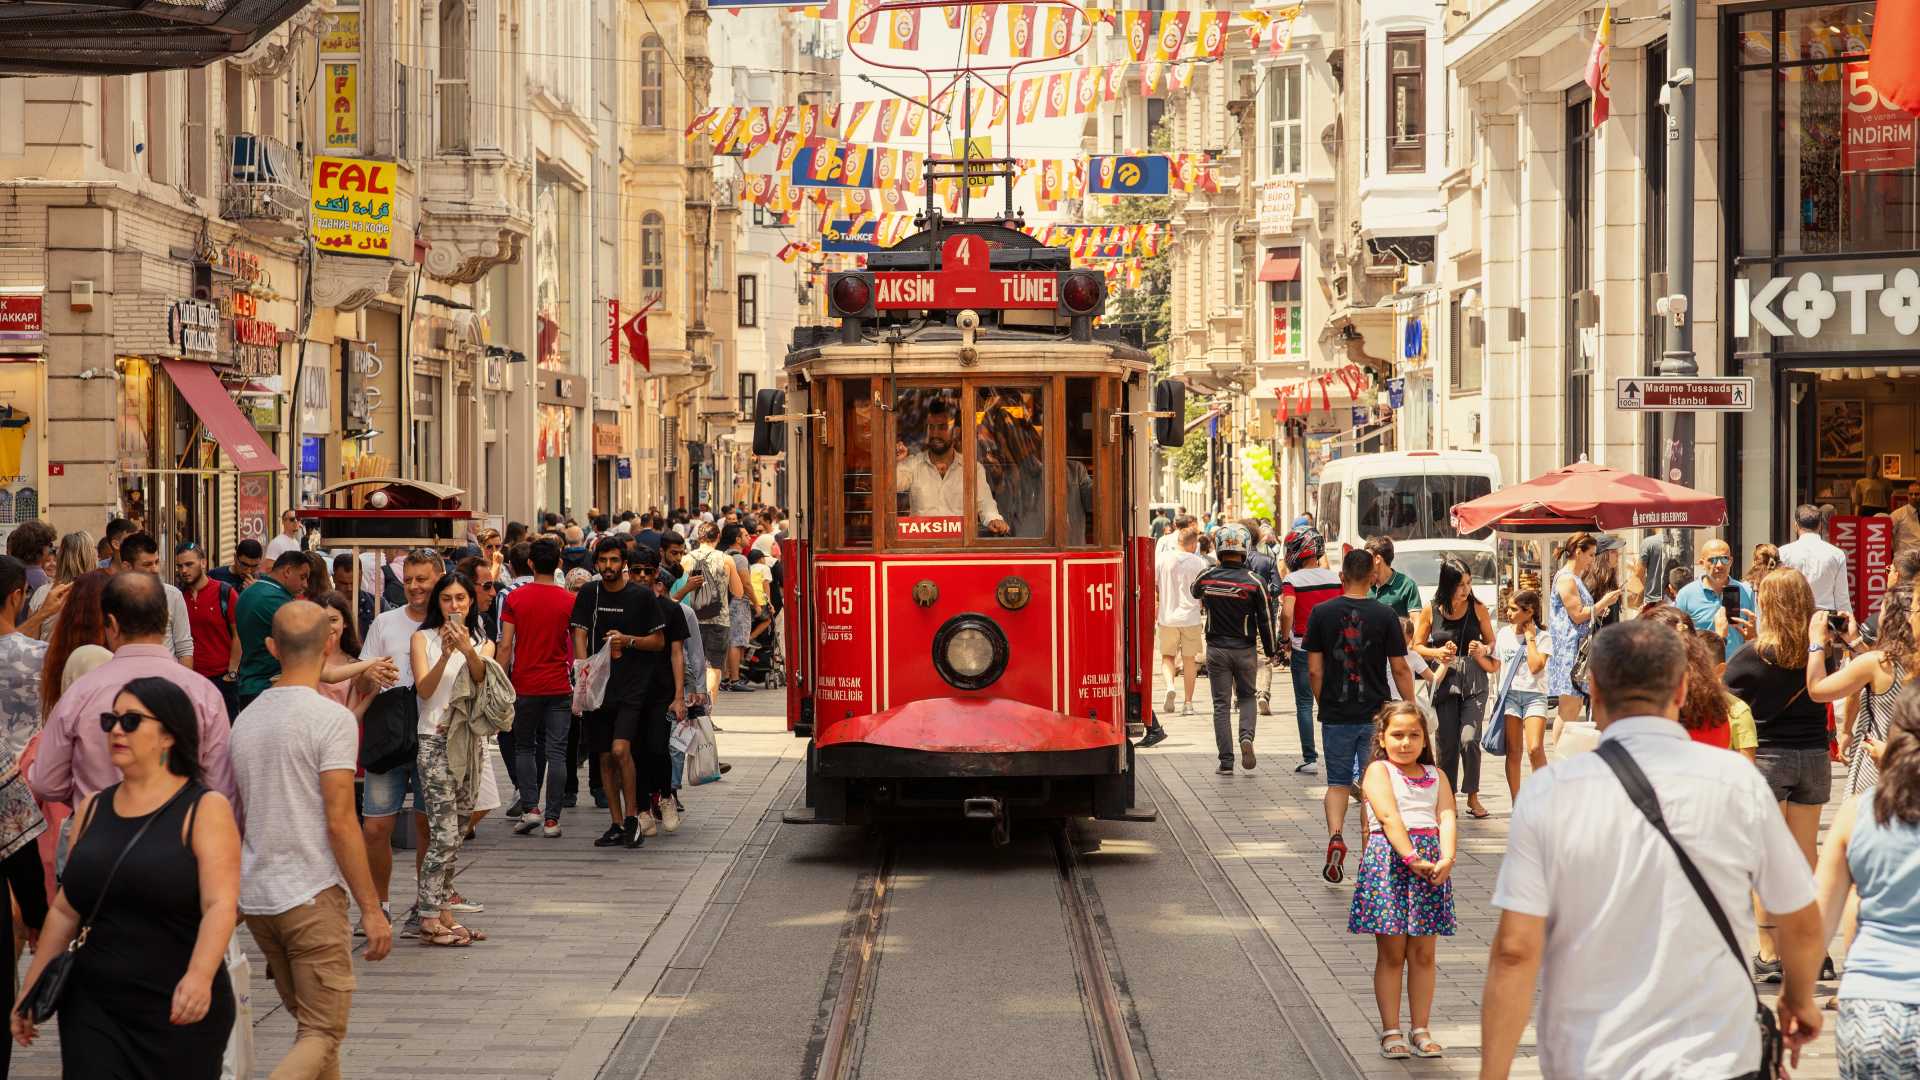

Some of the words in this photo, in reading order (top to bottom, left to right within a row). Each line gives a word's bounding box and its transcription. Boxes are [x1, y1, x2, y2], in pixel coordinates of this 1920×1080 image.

[319, 161, 389, 194] FAL
[955, 238, 970, 266] 4
[874, 274, 935, 303] AKSİM
[0, 312, 38, 323] AKKAPI
[1645, 383, 1684, 393] Madame
[1686, 383, 1731, 393] Tussauds
[1619, 399, 1639, 407] 100m
[1669, 393, 1707, 405] İstanbul
[898, 519, 962, 534] TAKSİM
[827, 586, 853, 615] 115
[1086, 582, 1113, 612] 115
[840, 633, 853, 641] 153
[838, 676, 862, 688] YASAK
[1079, 687, 1090, 699] VE
